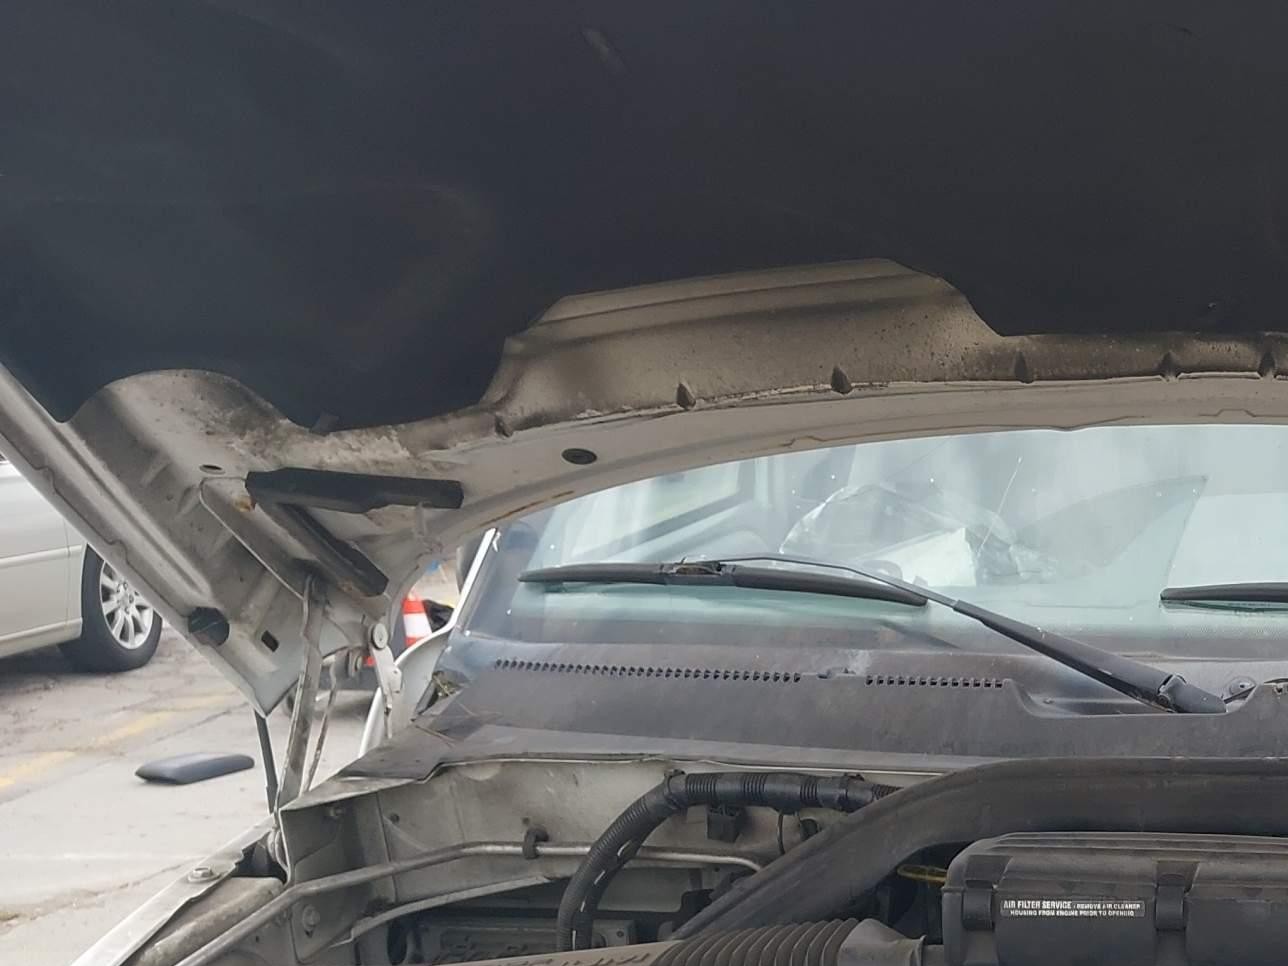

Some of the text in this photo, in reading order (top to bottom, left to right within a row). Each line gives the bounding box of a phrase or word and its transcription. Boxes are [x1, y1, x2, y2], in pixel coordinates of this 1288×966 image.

[1003, 900, 1016, 909] AIR
[1018, 900, 1040, 909] FILTER
[1042, 900, 1072, 909] SERVICE
